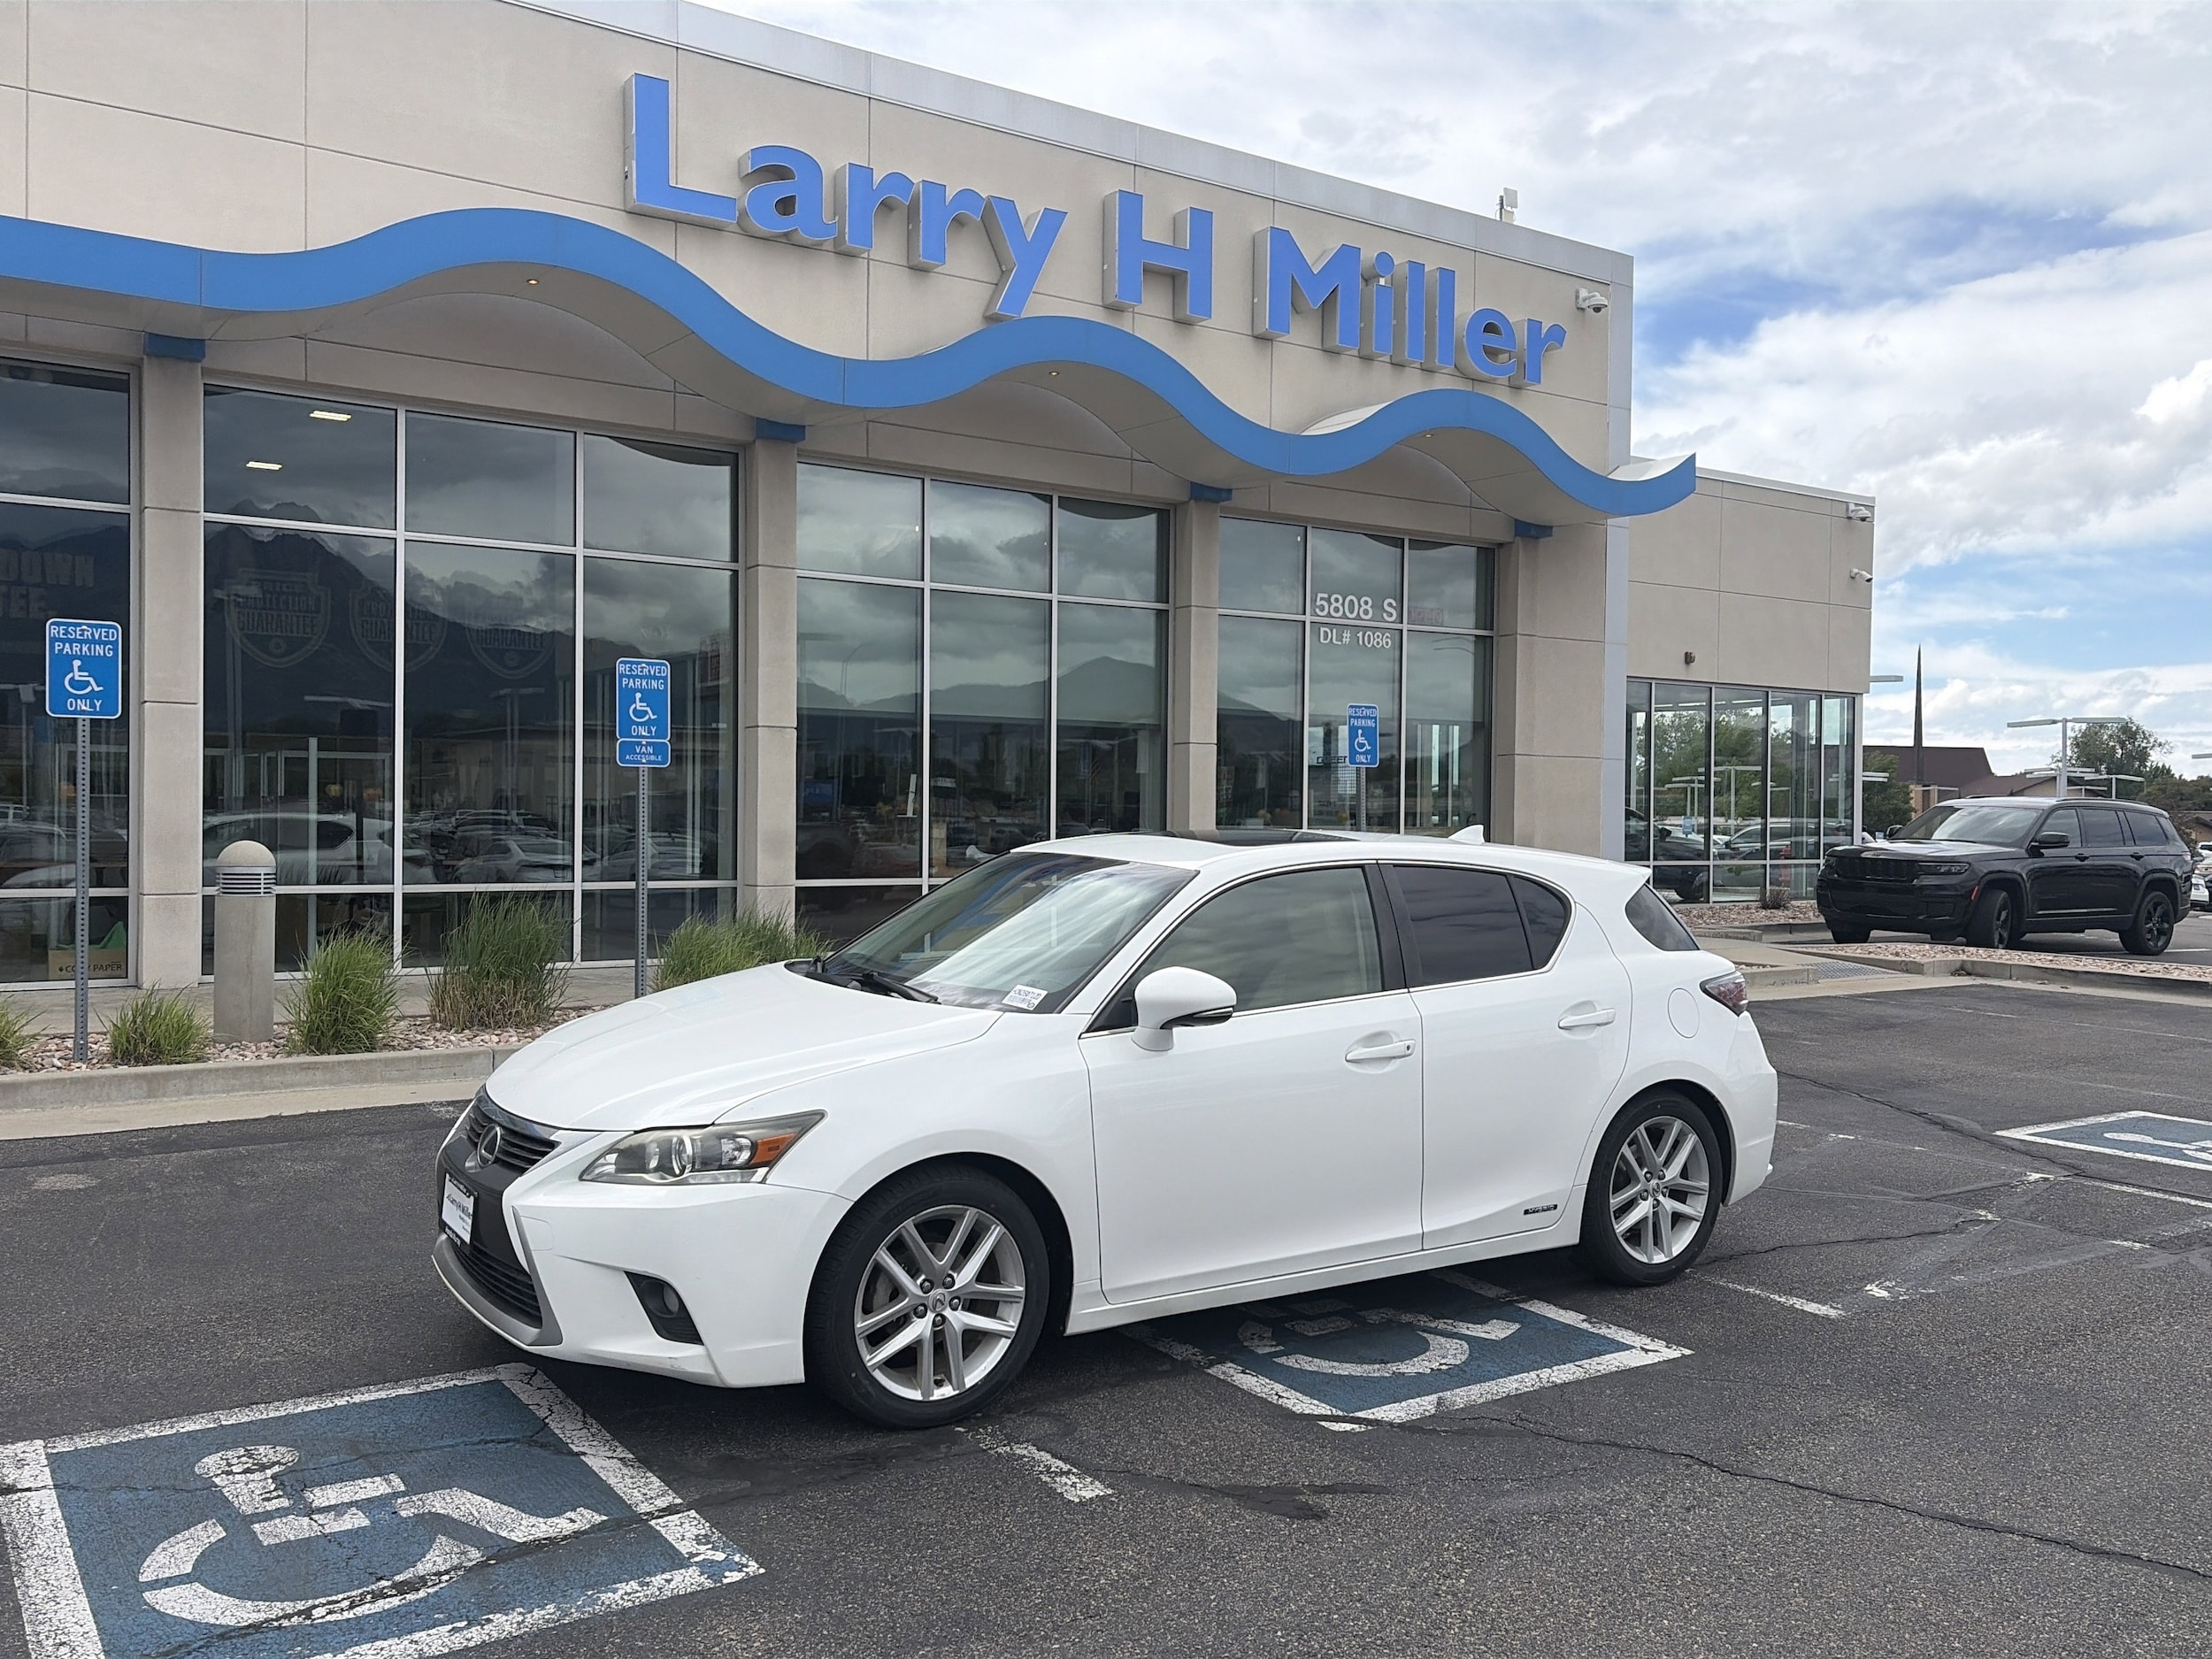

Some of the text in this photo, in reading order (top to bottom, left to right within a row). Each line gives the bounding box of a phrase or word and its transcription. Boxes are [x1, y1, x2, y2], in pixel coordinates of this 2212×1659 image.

[626, 73, 1567, 388] Larry H Miller
[1315, 593, 1397, 621] 5808 S
[50, 626, 117, 641] RESERVED
[1319, 627, 1392, 649] DL# 1086
[55, 642, 113, 657] PARKING
[619, 664, 667, 676] RESERVED
[622, 678, 664, 690] PARKING
[67, 698, 103, 711] ONLY
[1348, 708, 1377, 717] RESERVED
[1350, 718, 1376, 727] PARKING
[631, 726, 657, 736] ONLY
[1356, 754, 1371, 763] ONLY
